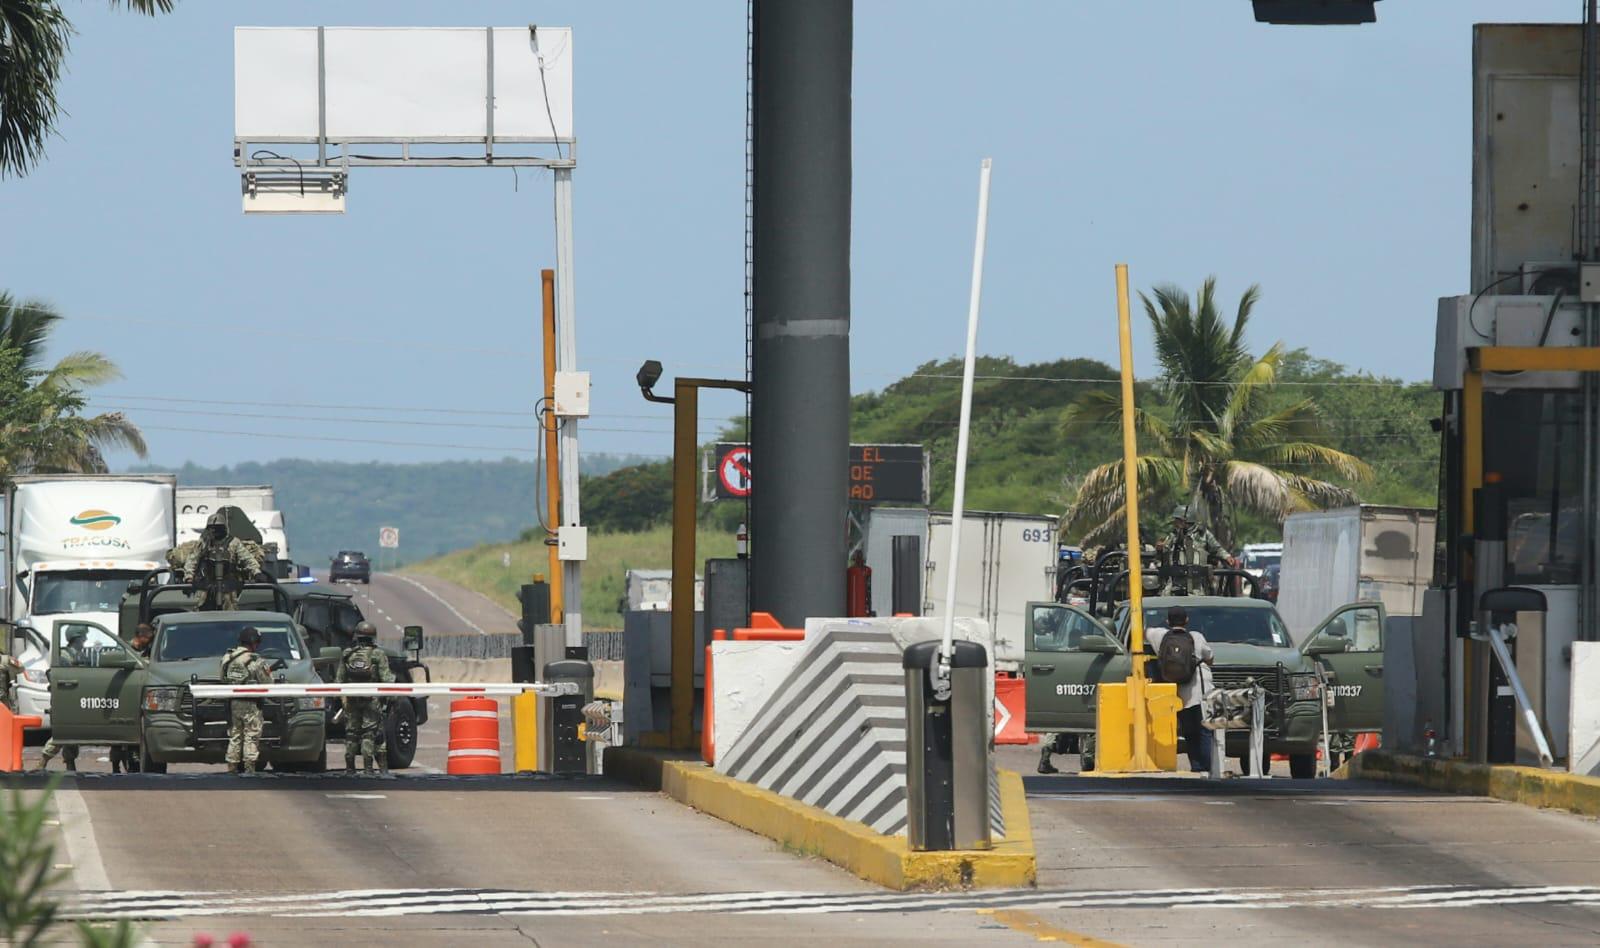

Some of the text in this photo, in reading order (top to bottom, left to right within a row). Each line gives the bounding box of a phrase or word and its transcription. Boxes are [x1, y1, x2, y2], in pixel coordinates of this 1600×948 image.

[864, 448, 885, 462] EL
[61, 535, 131, 549] TRACUSA
[1023, 528, 1050, 542] 693
[1056, 684, 1095, 696] 8110337
[80, 697, 119, 709] 8110338
